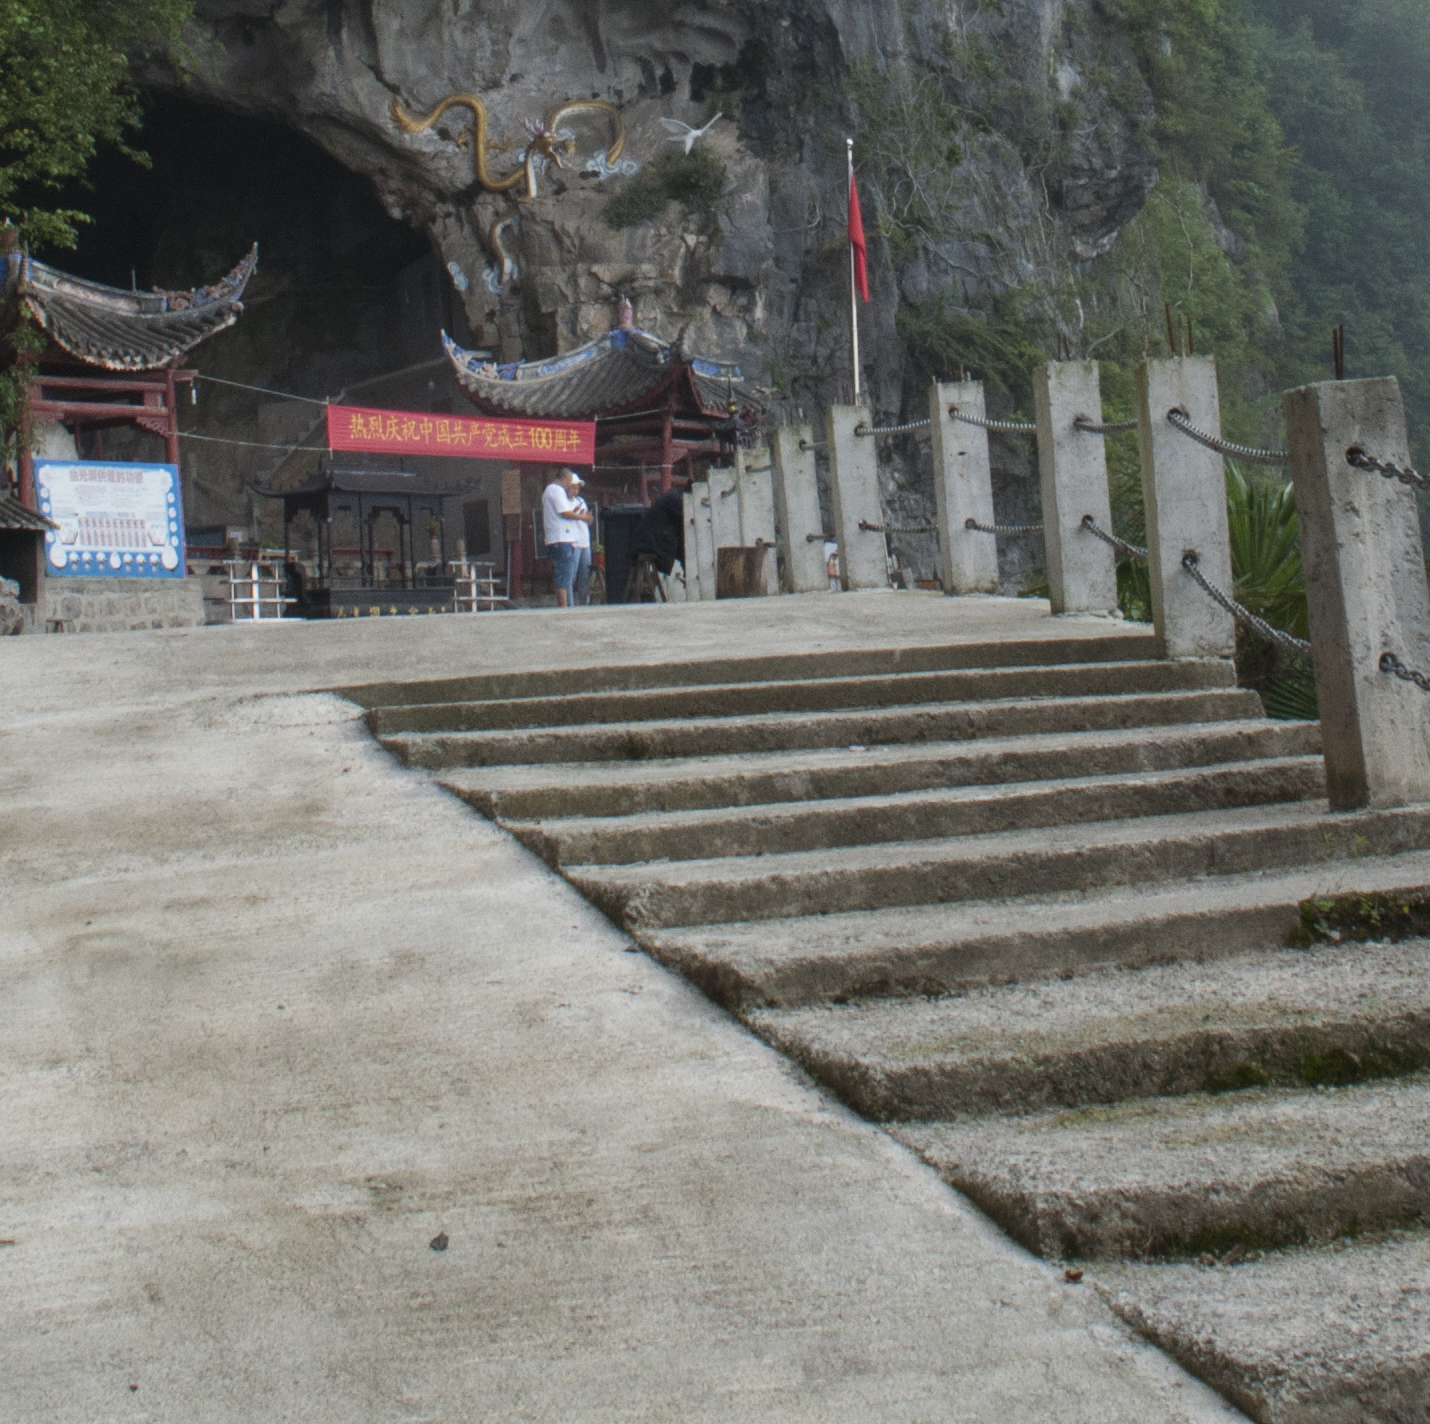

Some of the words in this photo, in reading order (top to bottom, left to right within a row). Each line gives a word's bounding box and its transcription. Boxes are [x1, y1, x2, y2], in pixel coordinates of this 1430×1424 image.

[349, 414, 581, 452] 热烈庆祝中国共产党成立100周年
